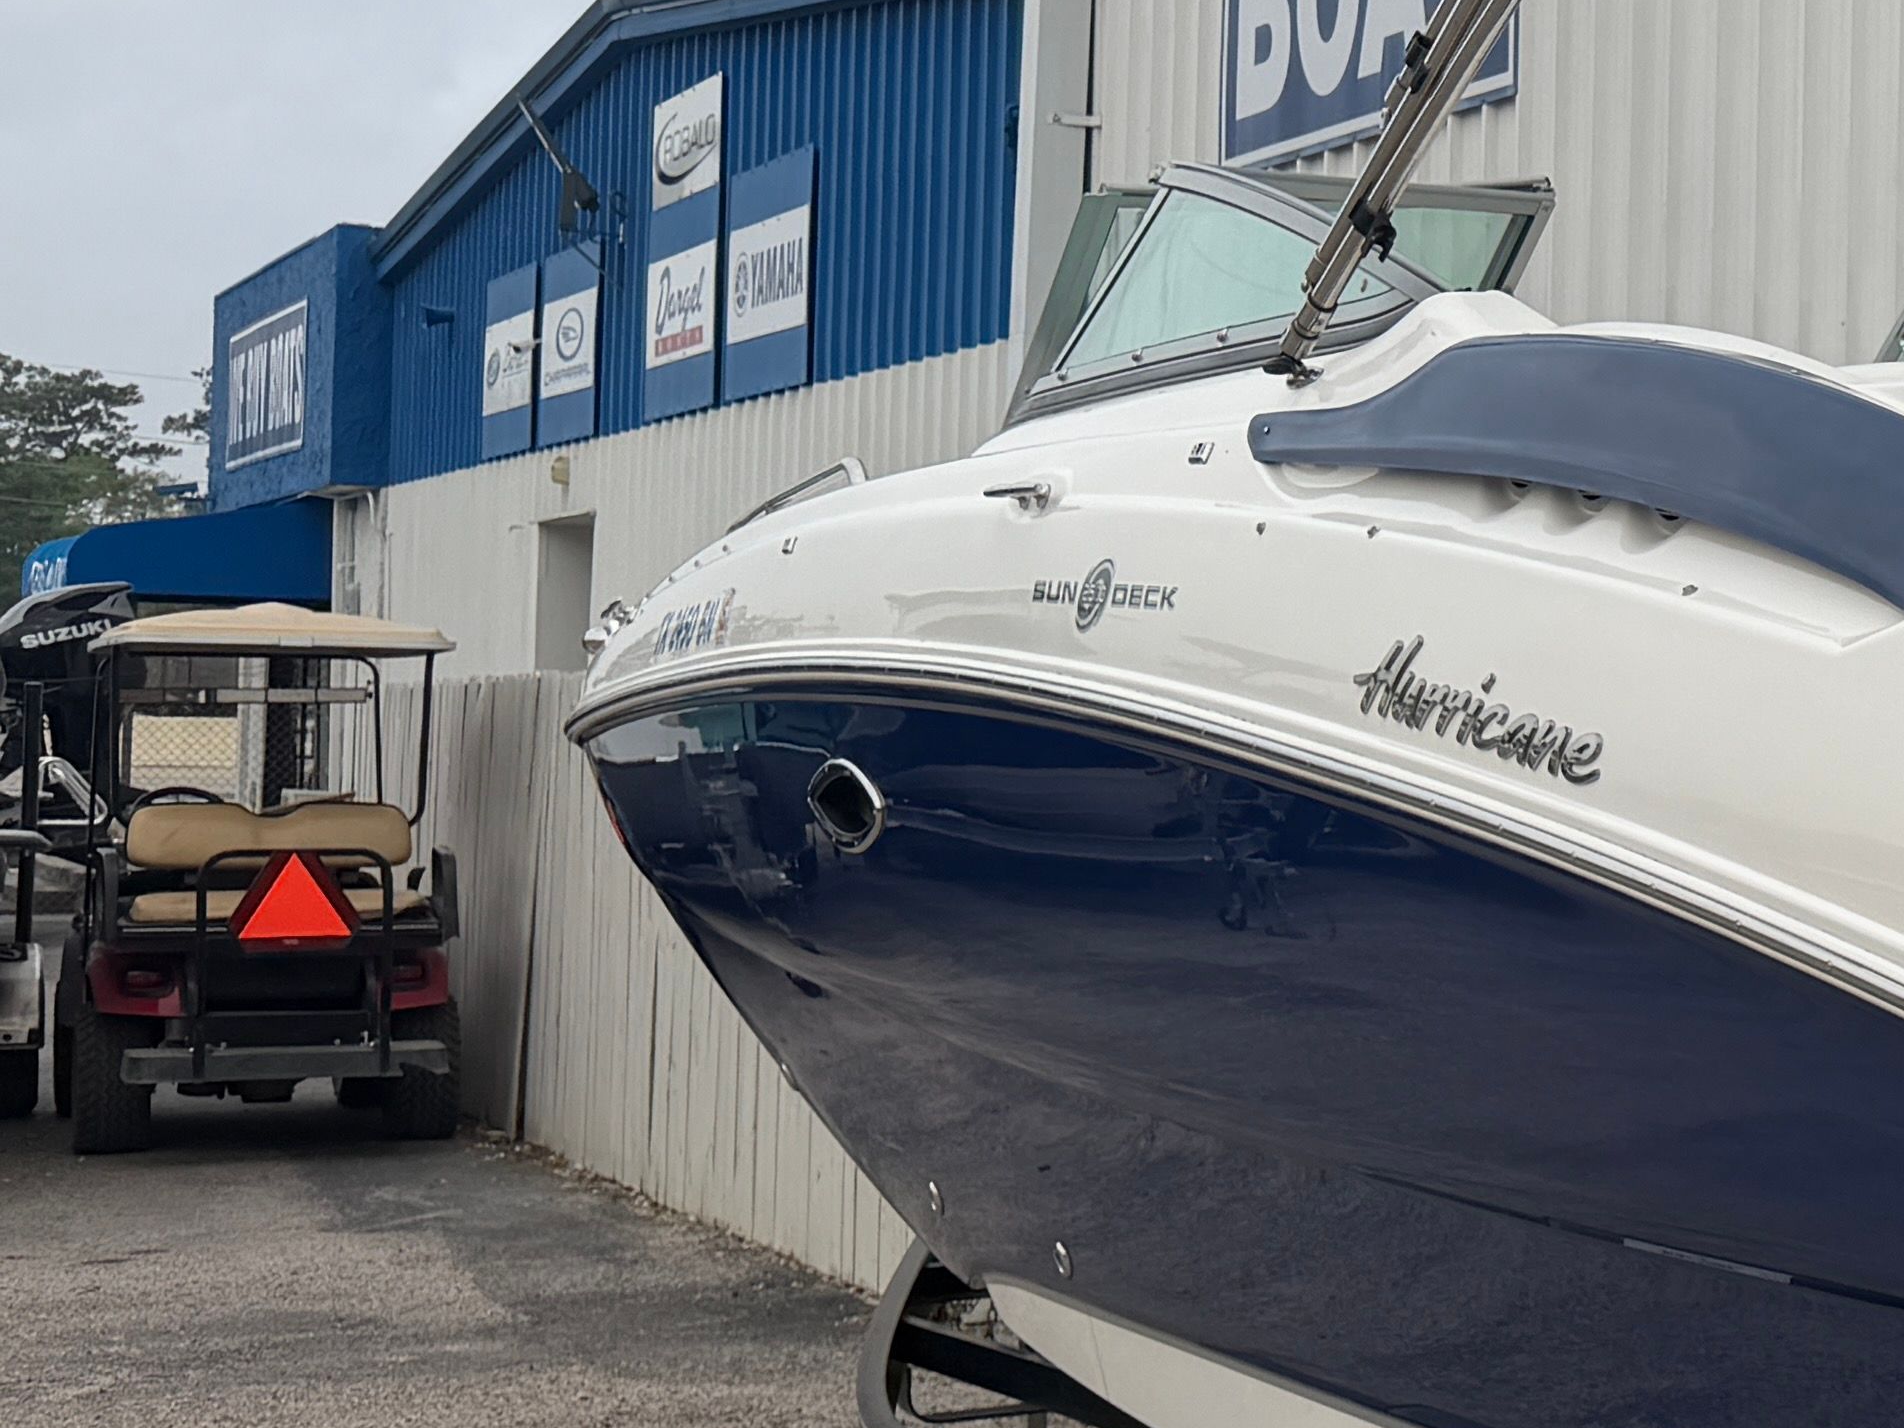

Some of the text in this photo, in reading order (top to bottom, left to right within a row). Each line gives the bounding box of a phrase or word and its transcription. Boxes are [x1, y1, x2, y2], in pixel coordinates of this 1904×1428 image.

[664, 113, 716, 164] ROBALO
[655, 265, 705, 336] Dargel
[751, 237, 803, 309] YAMAHA
[246, 340, 268, 439] BUY
[268, 323, 304, 432] BOATS
[1032, 579, 1079, 604] SUN
[1111, 583, 1179, 611] DECK
[20, 618, 112, 650] SUZUKI
[1353, 634, 1605, 785] Hurricane
